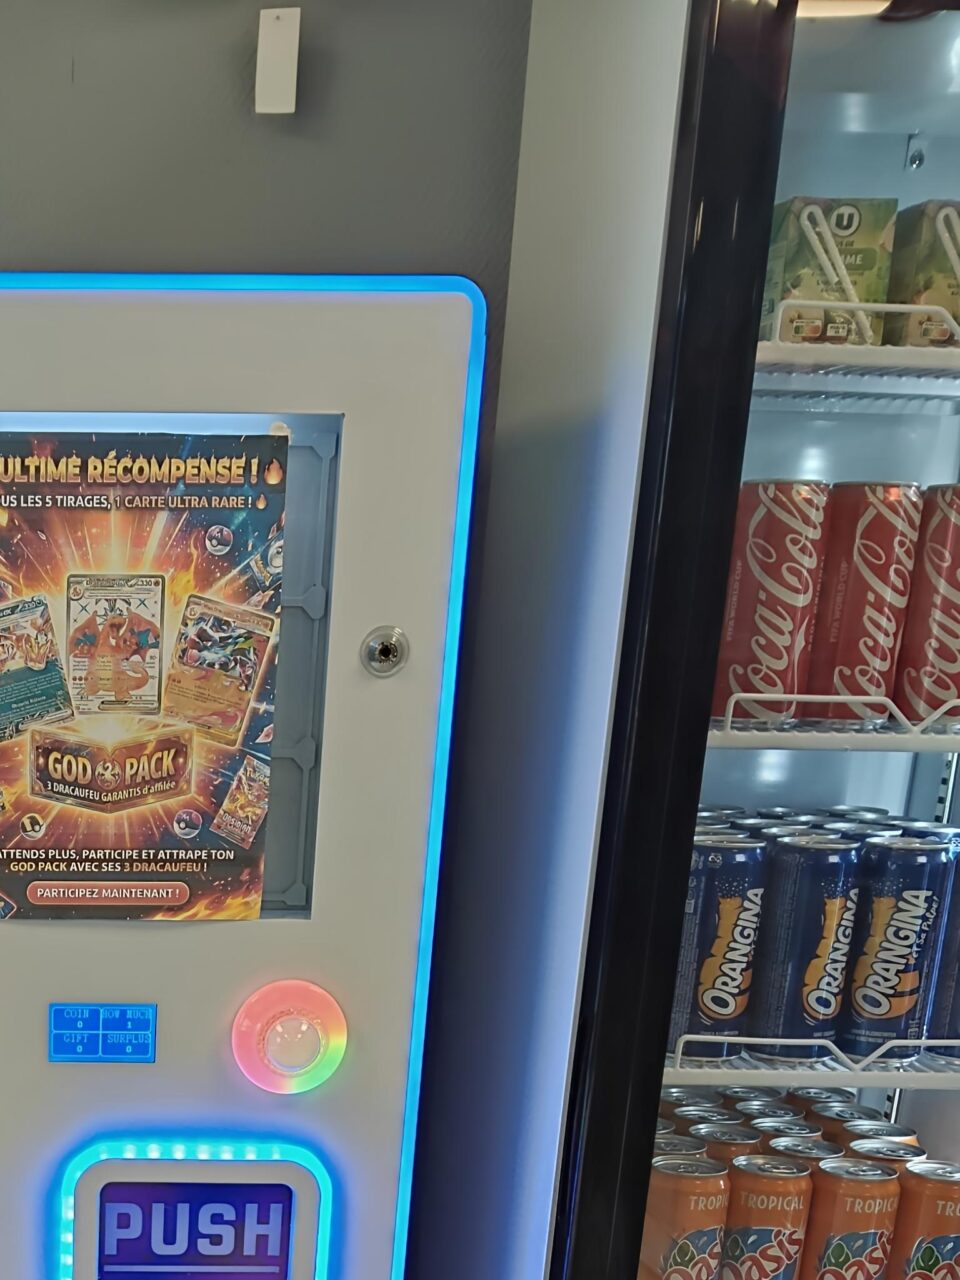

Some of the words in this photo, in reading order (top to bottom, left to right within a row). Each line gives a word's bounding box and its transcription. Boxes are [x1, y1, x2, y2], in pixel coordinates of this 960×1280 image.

[87, 449, 246, 484] RÉCOMPENSE
[251, 455, 258, 484] !
[20, 495, 41, 507] LES
[45, 495, 52, 507] 5
[55, 495, 111, 509] TIRAGES,
[115, 496, 120, 507] 1
[124, 496, 165, 508] CARTE
[168, 496, 208, 508] ULTRA
[211, 496, 245, 508] RARE
[248, 496, 251, 508] !
[48, 751, 92, 785] GOD
[125, 748, 177, 785] PACK
[46, 781, 52, 790] 3
[53, 782, 99, 800] DRACAUFEU
[102, 786, 141, 801] GARANTIS
[142, 780, 176, 794] d'affilée
[48, 849, 79, 861] PLUS,
[82, 849, 139, 859] PARTICIPE
[142, 850, 155, 859] ET
[157, 850, 208, 860] ATTRAPE
[210, 850, 234, 860] TON
[10, 861, 36, 871] GOD
[38, 862, 67, 871] PACK
[70, 862, 98, 872] AVEC
[101, 862, 121, 872] SES
[123, 862, 130, 872] 3
[133, 862, 201, 872] DRACAUFEU
[37, 888, 98, 898] PARTICIPEZ
[102, 888, 174, 898] MAINTENANT
[702, 887, 765, 1016] ORANGINA
[807, 887, 860, 1016] ORANGINA
[854, 889, 934, 1015] ORANGINA
[64, 1009, 89, 1018] COIN
[101, 1009, 120, 1019] HOW
[126, 1009, 151, 1019] MUCH
[63, 1034, 89, 1043] GIFT
[107, 1034, 151, 1043] SURPLUS
[126, 1045, 132, 1053] 0
[741, 1193, 804, 1210] TROPICAL
[104, 1202, 283, 1256] PUSH
